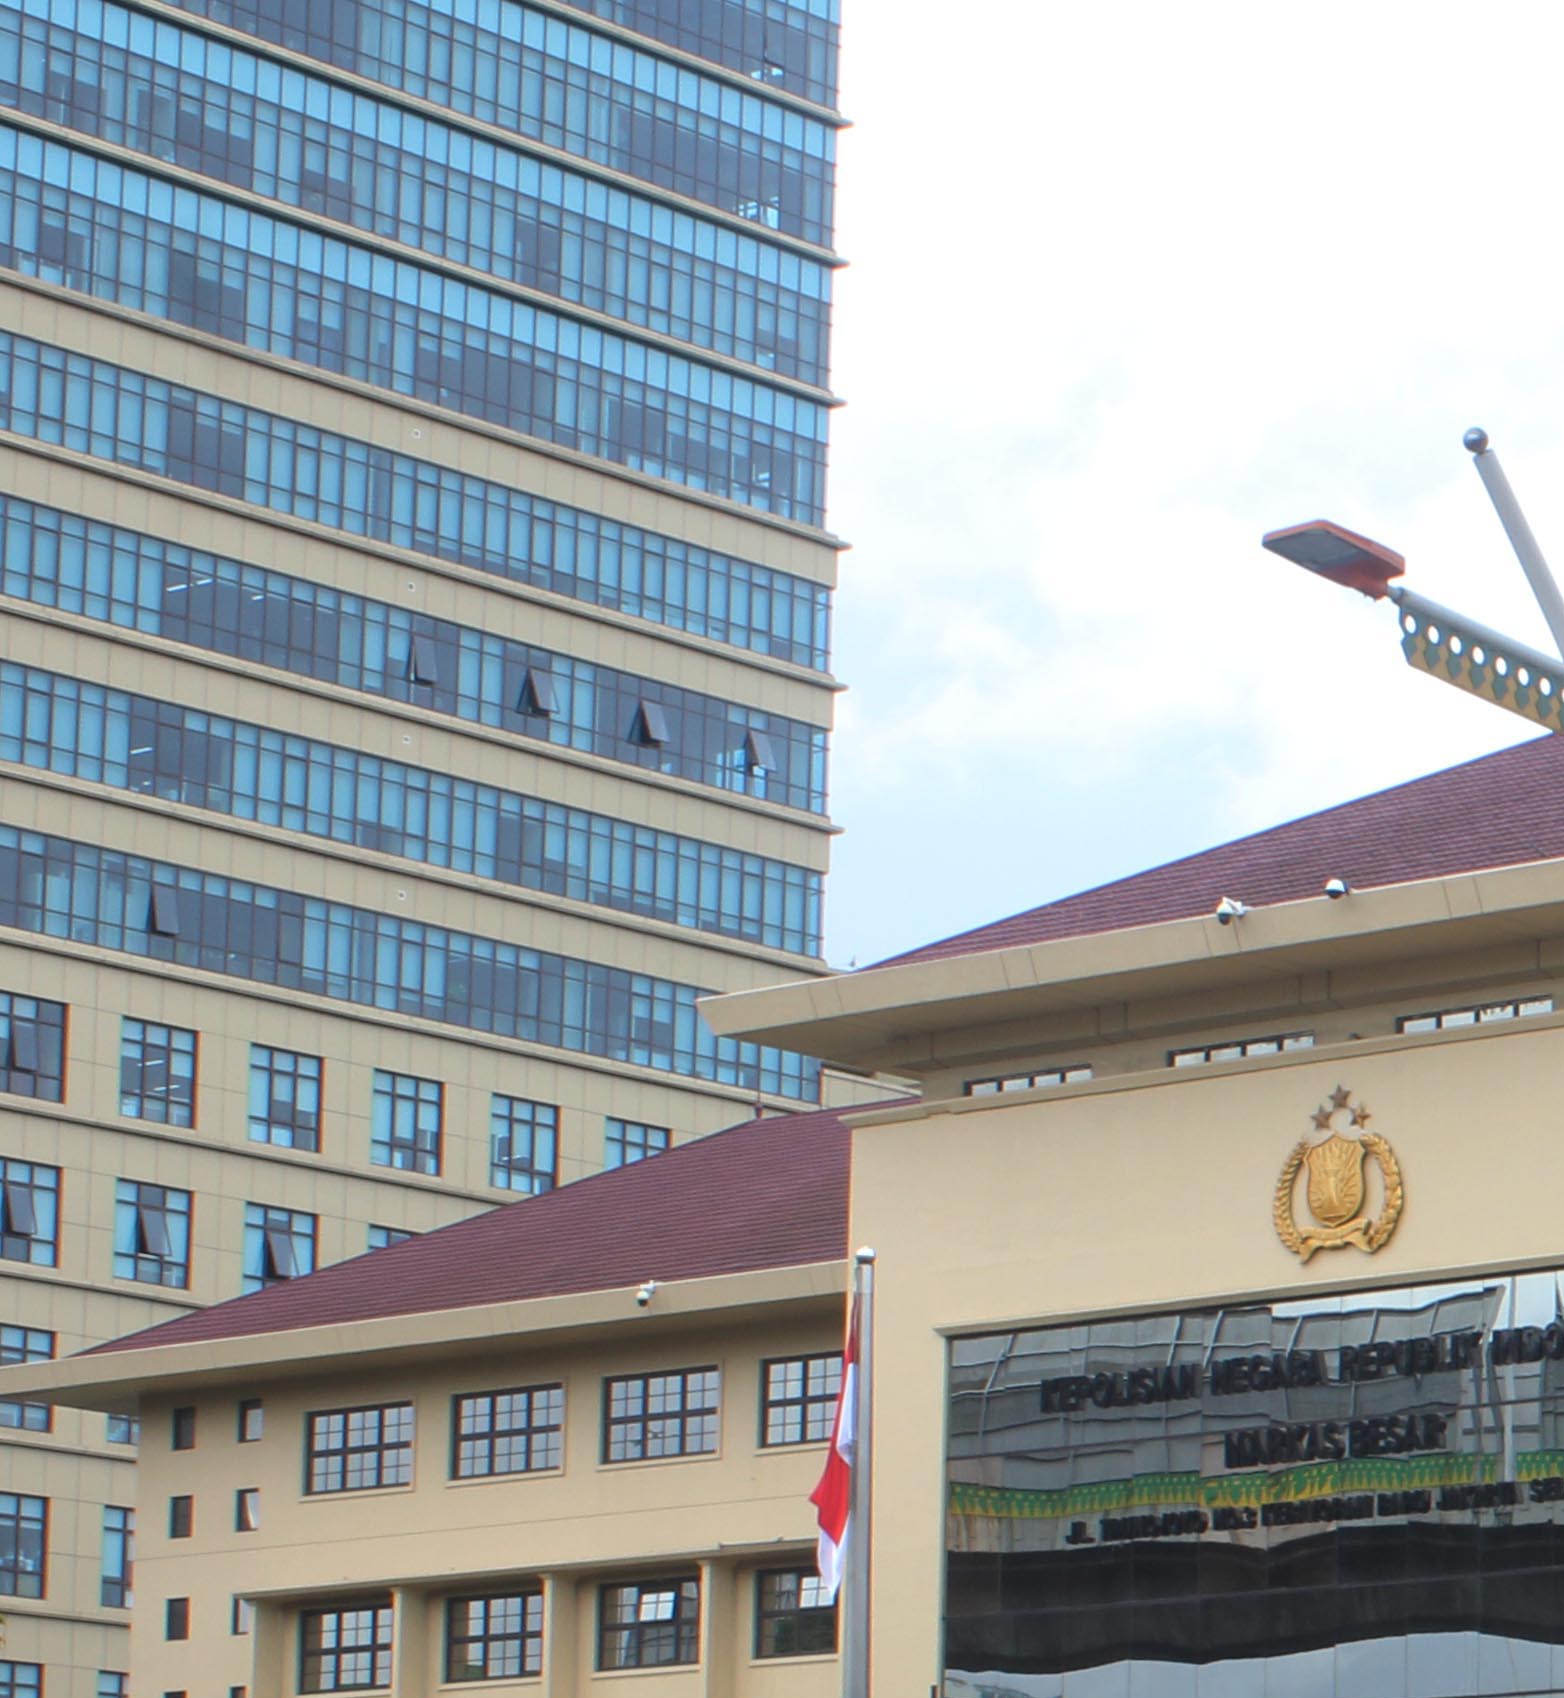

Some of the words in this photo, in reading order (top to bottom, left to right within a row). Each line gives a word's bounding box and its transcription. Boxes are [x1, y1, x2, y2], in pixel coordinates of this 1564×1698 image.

[1041, 1363, 1201, 1414] KEPOLISIAN
[1211, 1351, 1327, 1396] NEGARA
[1339, 1331, 1484, 1382] REPUBLIK
[1225, 1422, 1345, 1469] MARKAS
[1349, 1413, 1447, 1458] BESAR
